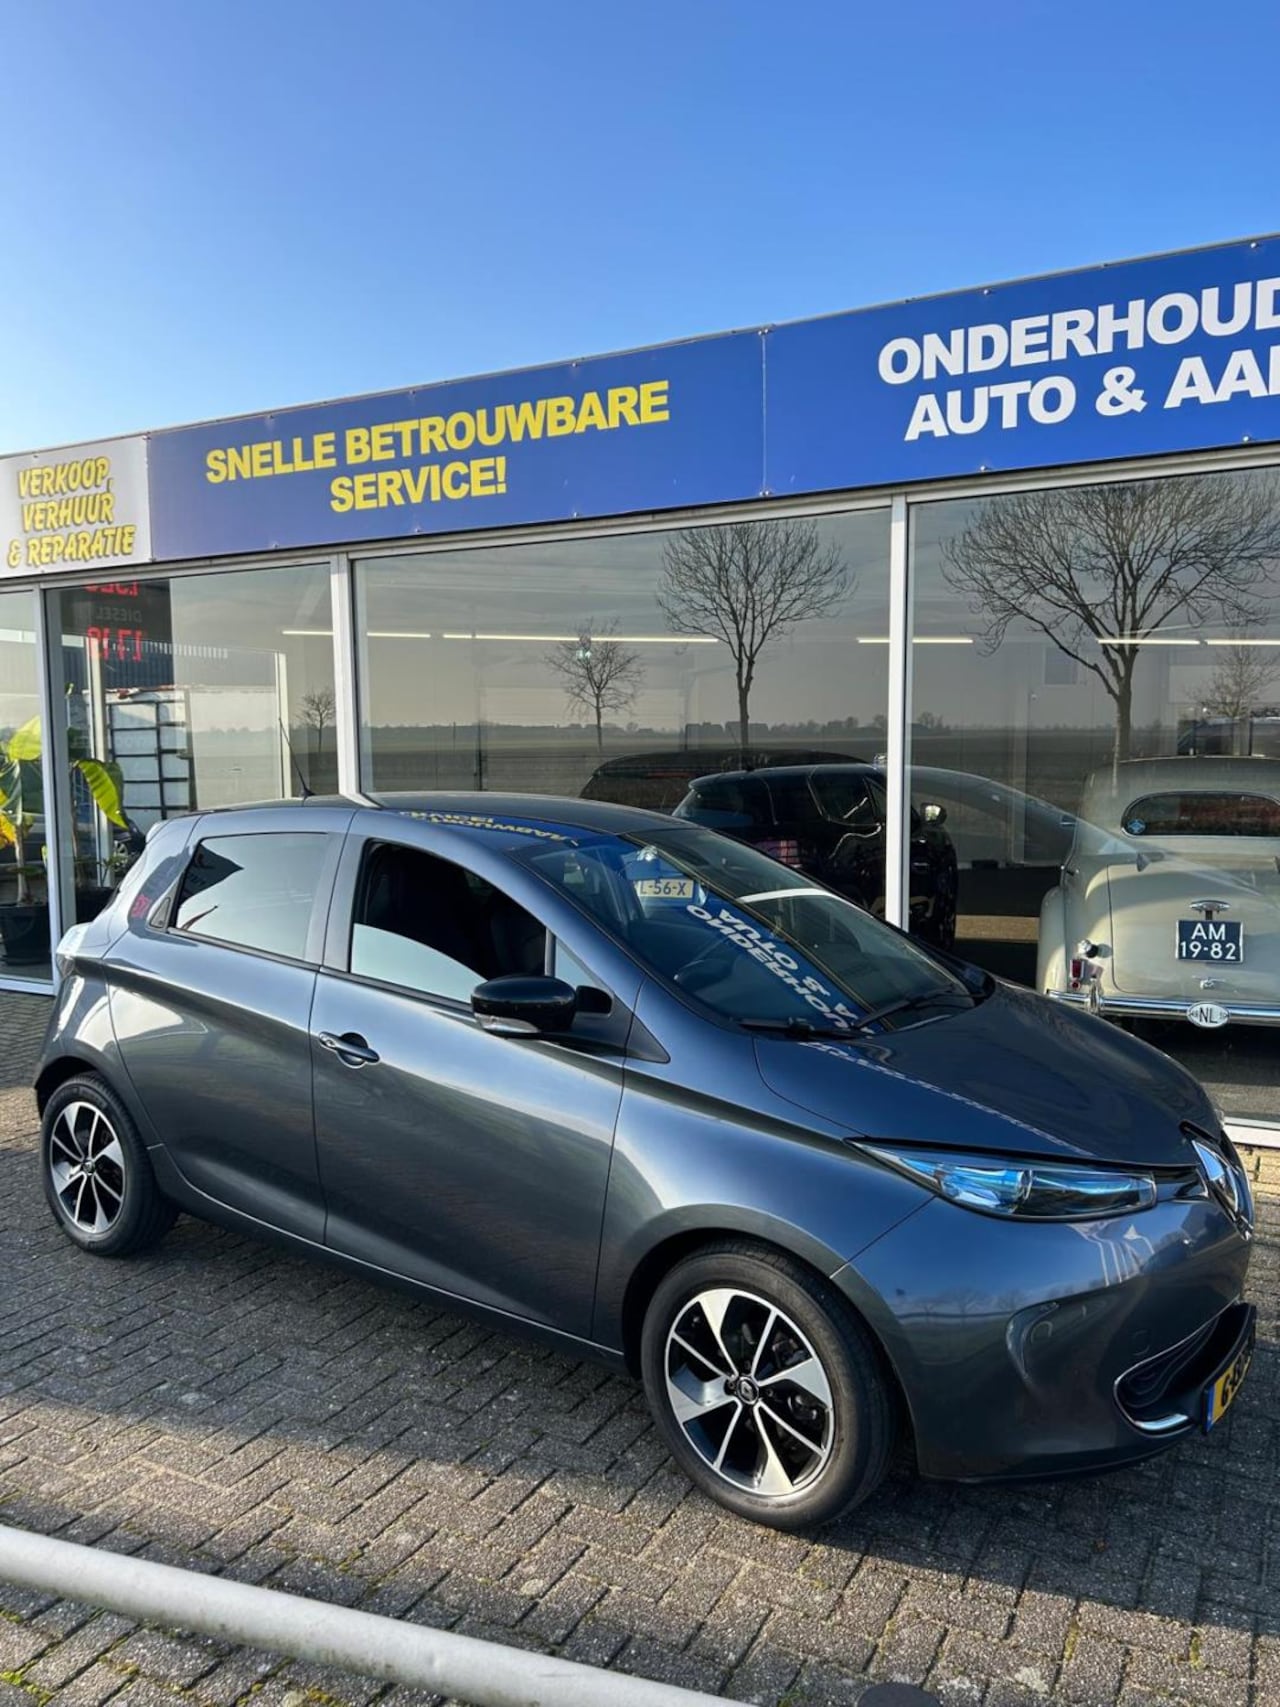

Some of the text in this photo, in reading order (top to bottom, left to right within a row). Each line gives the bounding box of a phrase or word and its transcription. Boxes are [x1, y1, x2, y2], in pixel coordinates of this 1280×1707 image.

[904, 345, 1280, 442] AUTO & AA
[206, 380, 670, 485] SNELLE BETROUWBARE
[18, 457, 113, 499] VERKOOP,
[330, 456, 507, 513] SERVICE!
[22, 493, 115, 533] VERHUUR
[7, 524, 137, 568] & REPARATIE
[1180, 941, 1237, 960] 19-82
[1191, 922, 1226, 941] AM
[1199, 1007, 1219, 1024] NL
